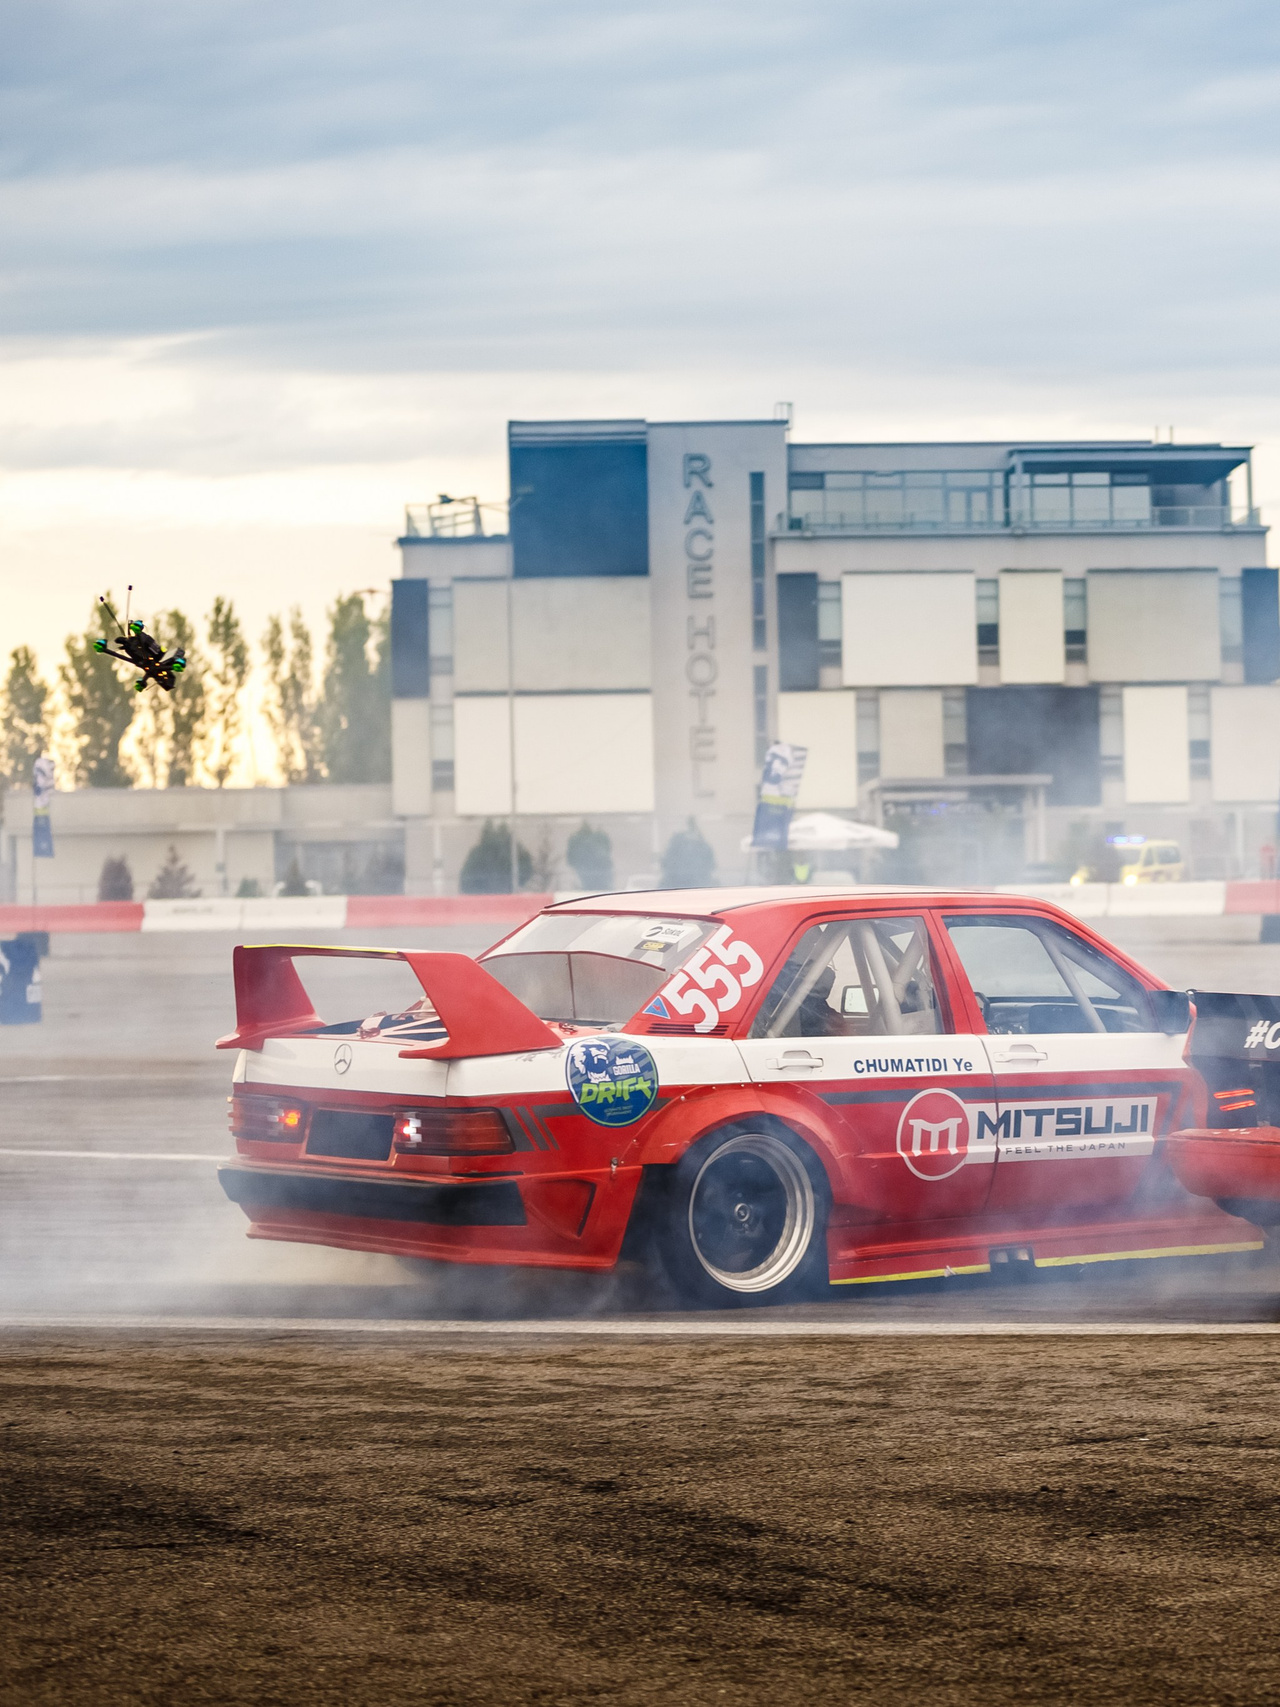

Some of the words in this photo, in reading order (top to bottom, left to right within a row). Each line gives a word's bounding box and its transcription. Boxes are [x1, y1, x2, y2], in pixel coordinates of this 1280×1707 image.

[682, 453, 714, 600] RACE
[685, 614, 719, 798] HOTEL
[659, 924, 764, 1034] 555
[612, 1063, 641, 1076] GORILLA
[853, 1058, 948, 1074] CHUMATIDI
[953, 1058, 973, 1072] Ye
[579, 1076, 652, 1105] DRIFT
[976, 1104, 1149, 1140] MITSUJI
[1005, 1145, 1041, 1156] FEEL
[1047, 1143, 1074, 1154] THE
[1079, 1141, 1126, 1153] JAPAN
